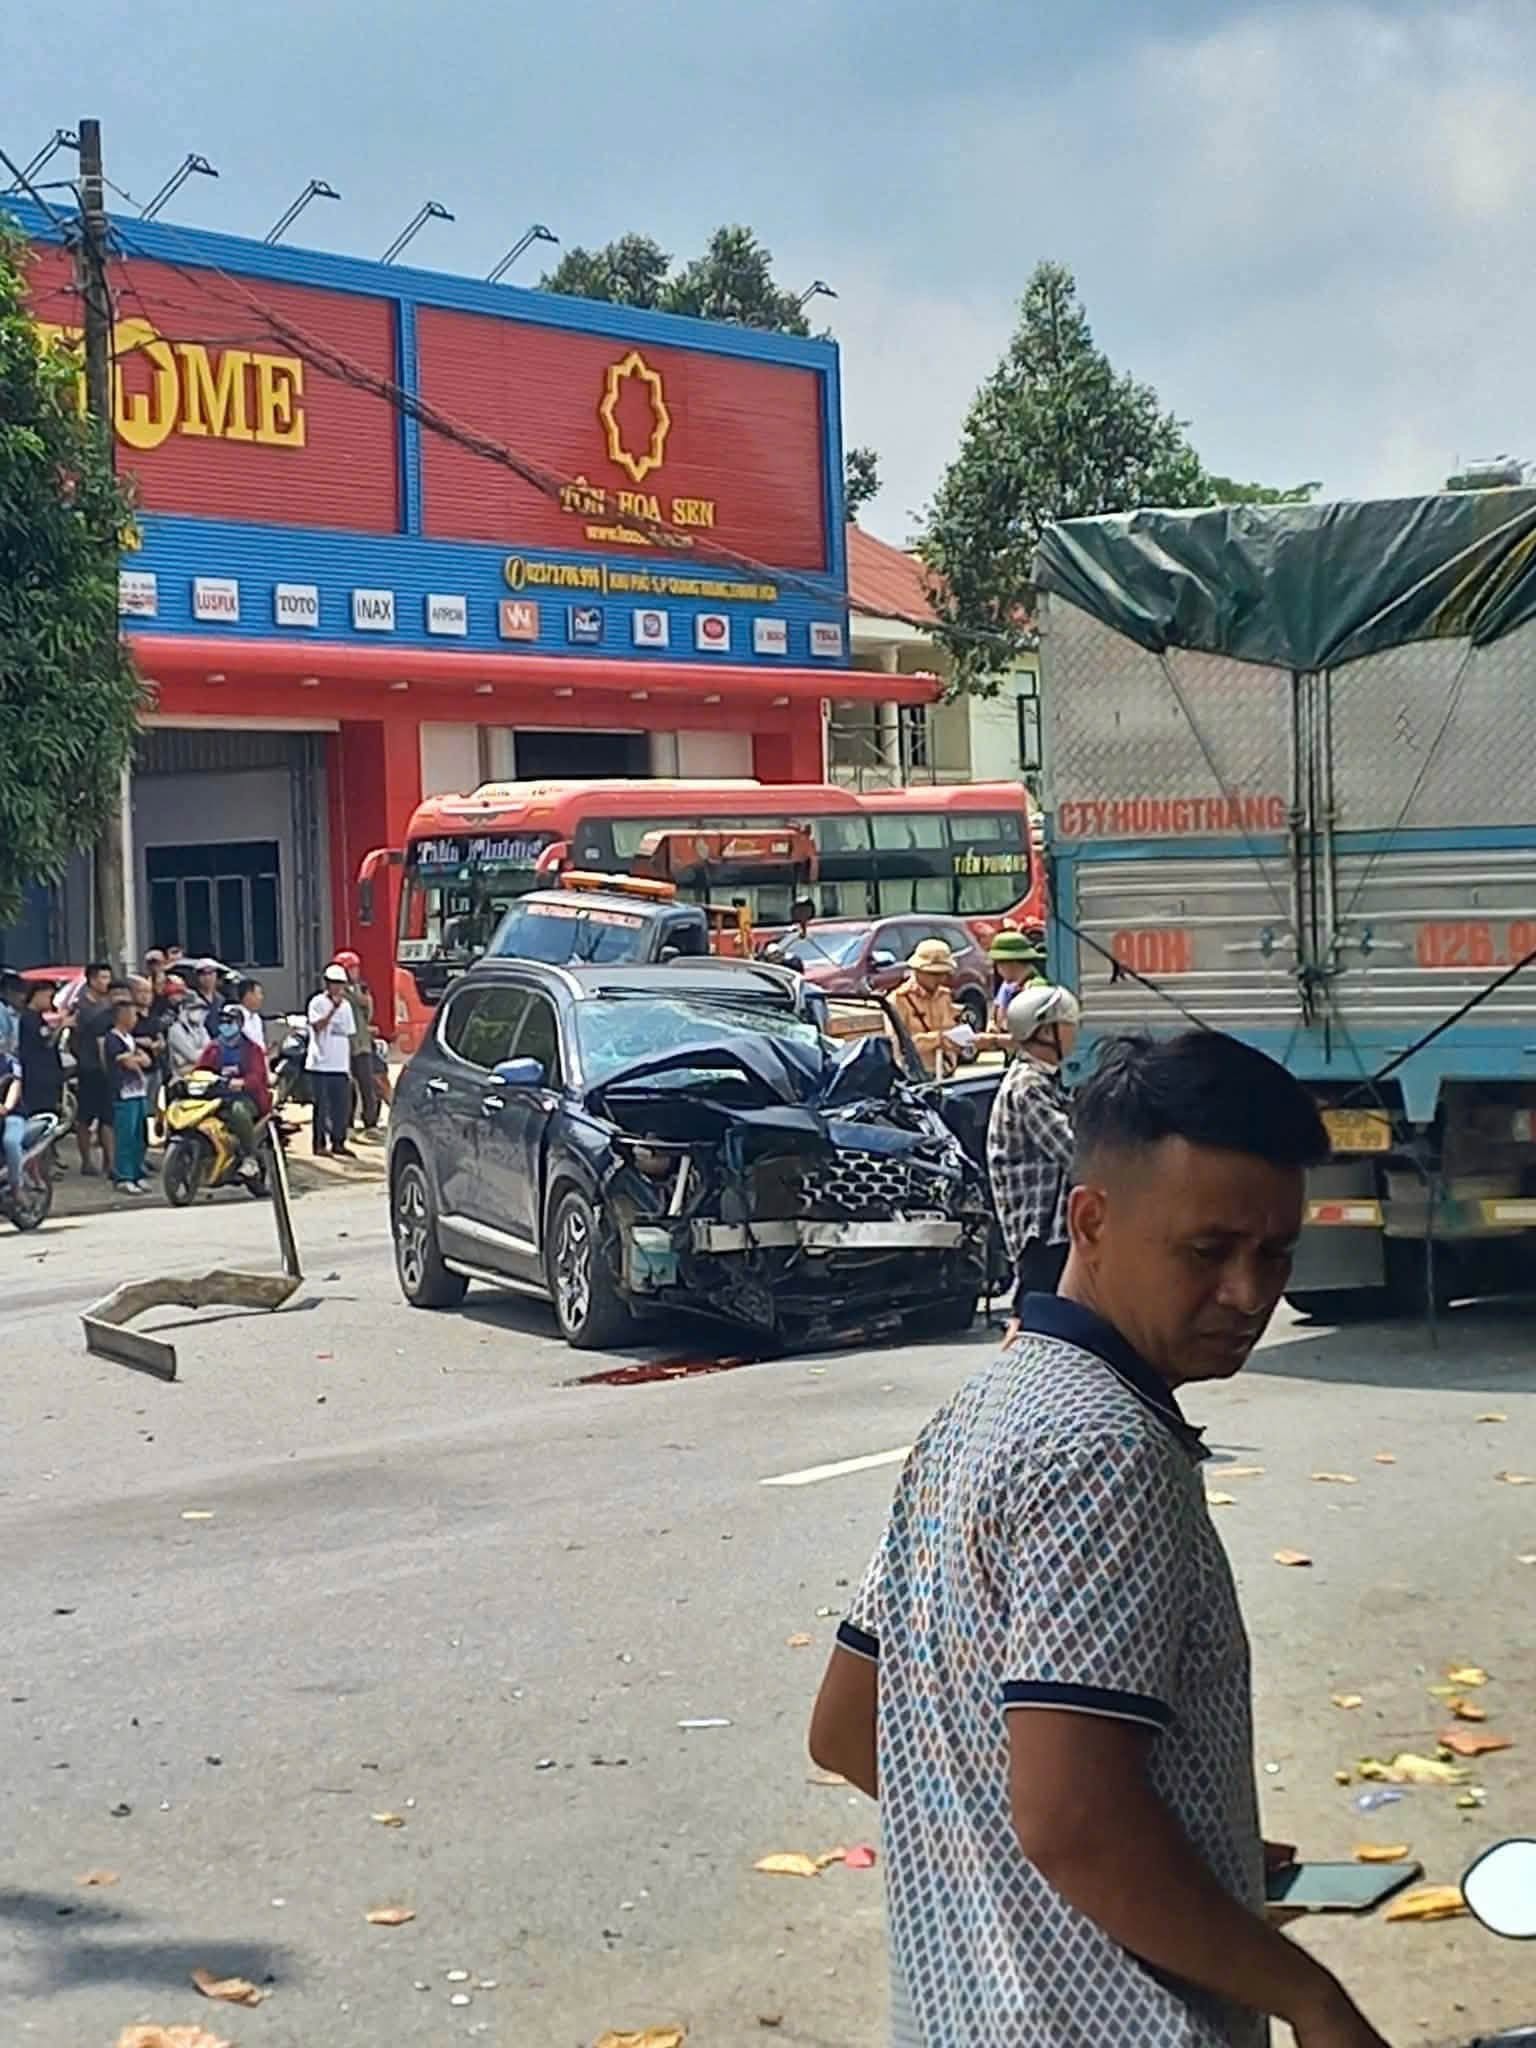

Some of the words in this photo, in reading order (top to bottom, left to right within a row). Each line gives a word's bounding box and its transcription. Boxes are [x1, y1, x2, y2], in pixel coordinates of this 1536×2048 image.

[616, 490, 661, 521] HOA
[672, 498, 714, 527] SEN
[279, 595, 317, 614] TOTO
